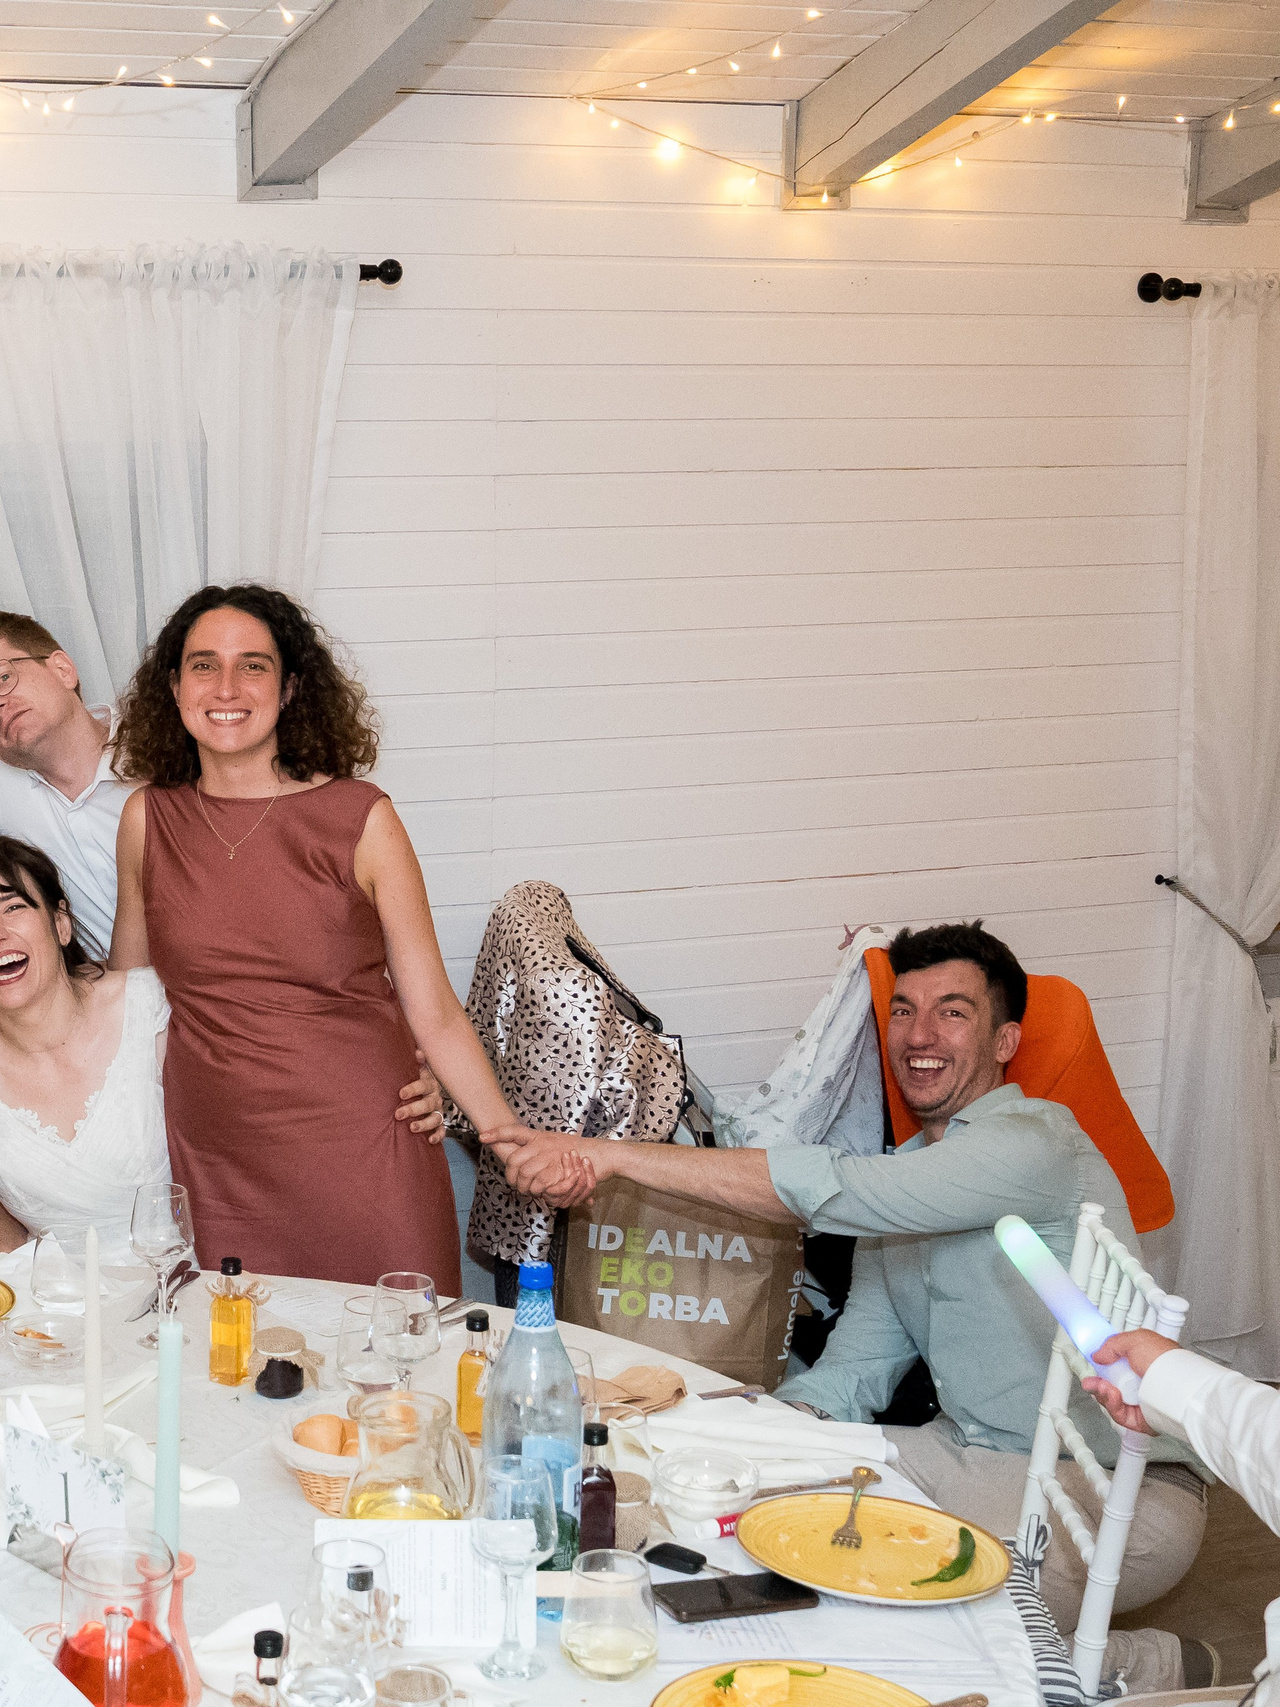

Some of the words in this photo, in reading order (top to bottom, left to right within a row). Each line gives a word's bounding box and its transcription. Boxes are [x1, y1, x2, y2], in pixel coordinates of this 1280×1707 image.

[587, 1223, 753, 1263] IDEALNA
[599, 1256, 675, 1288] EKO
[596, 1287, 730, 1325] TORBA
